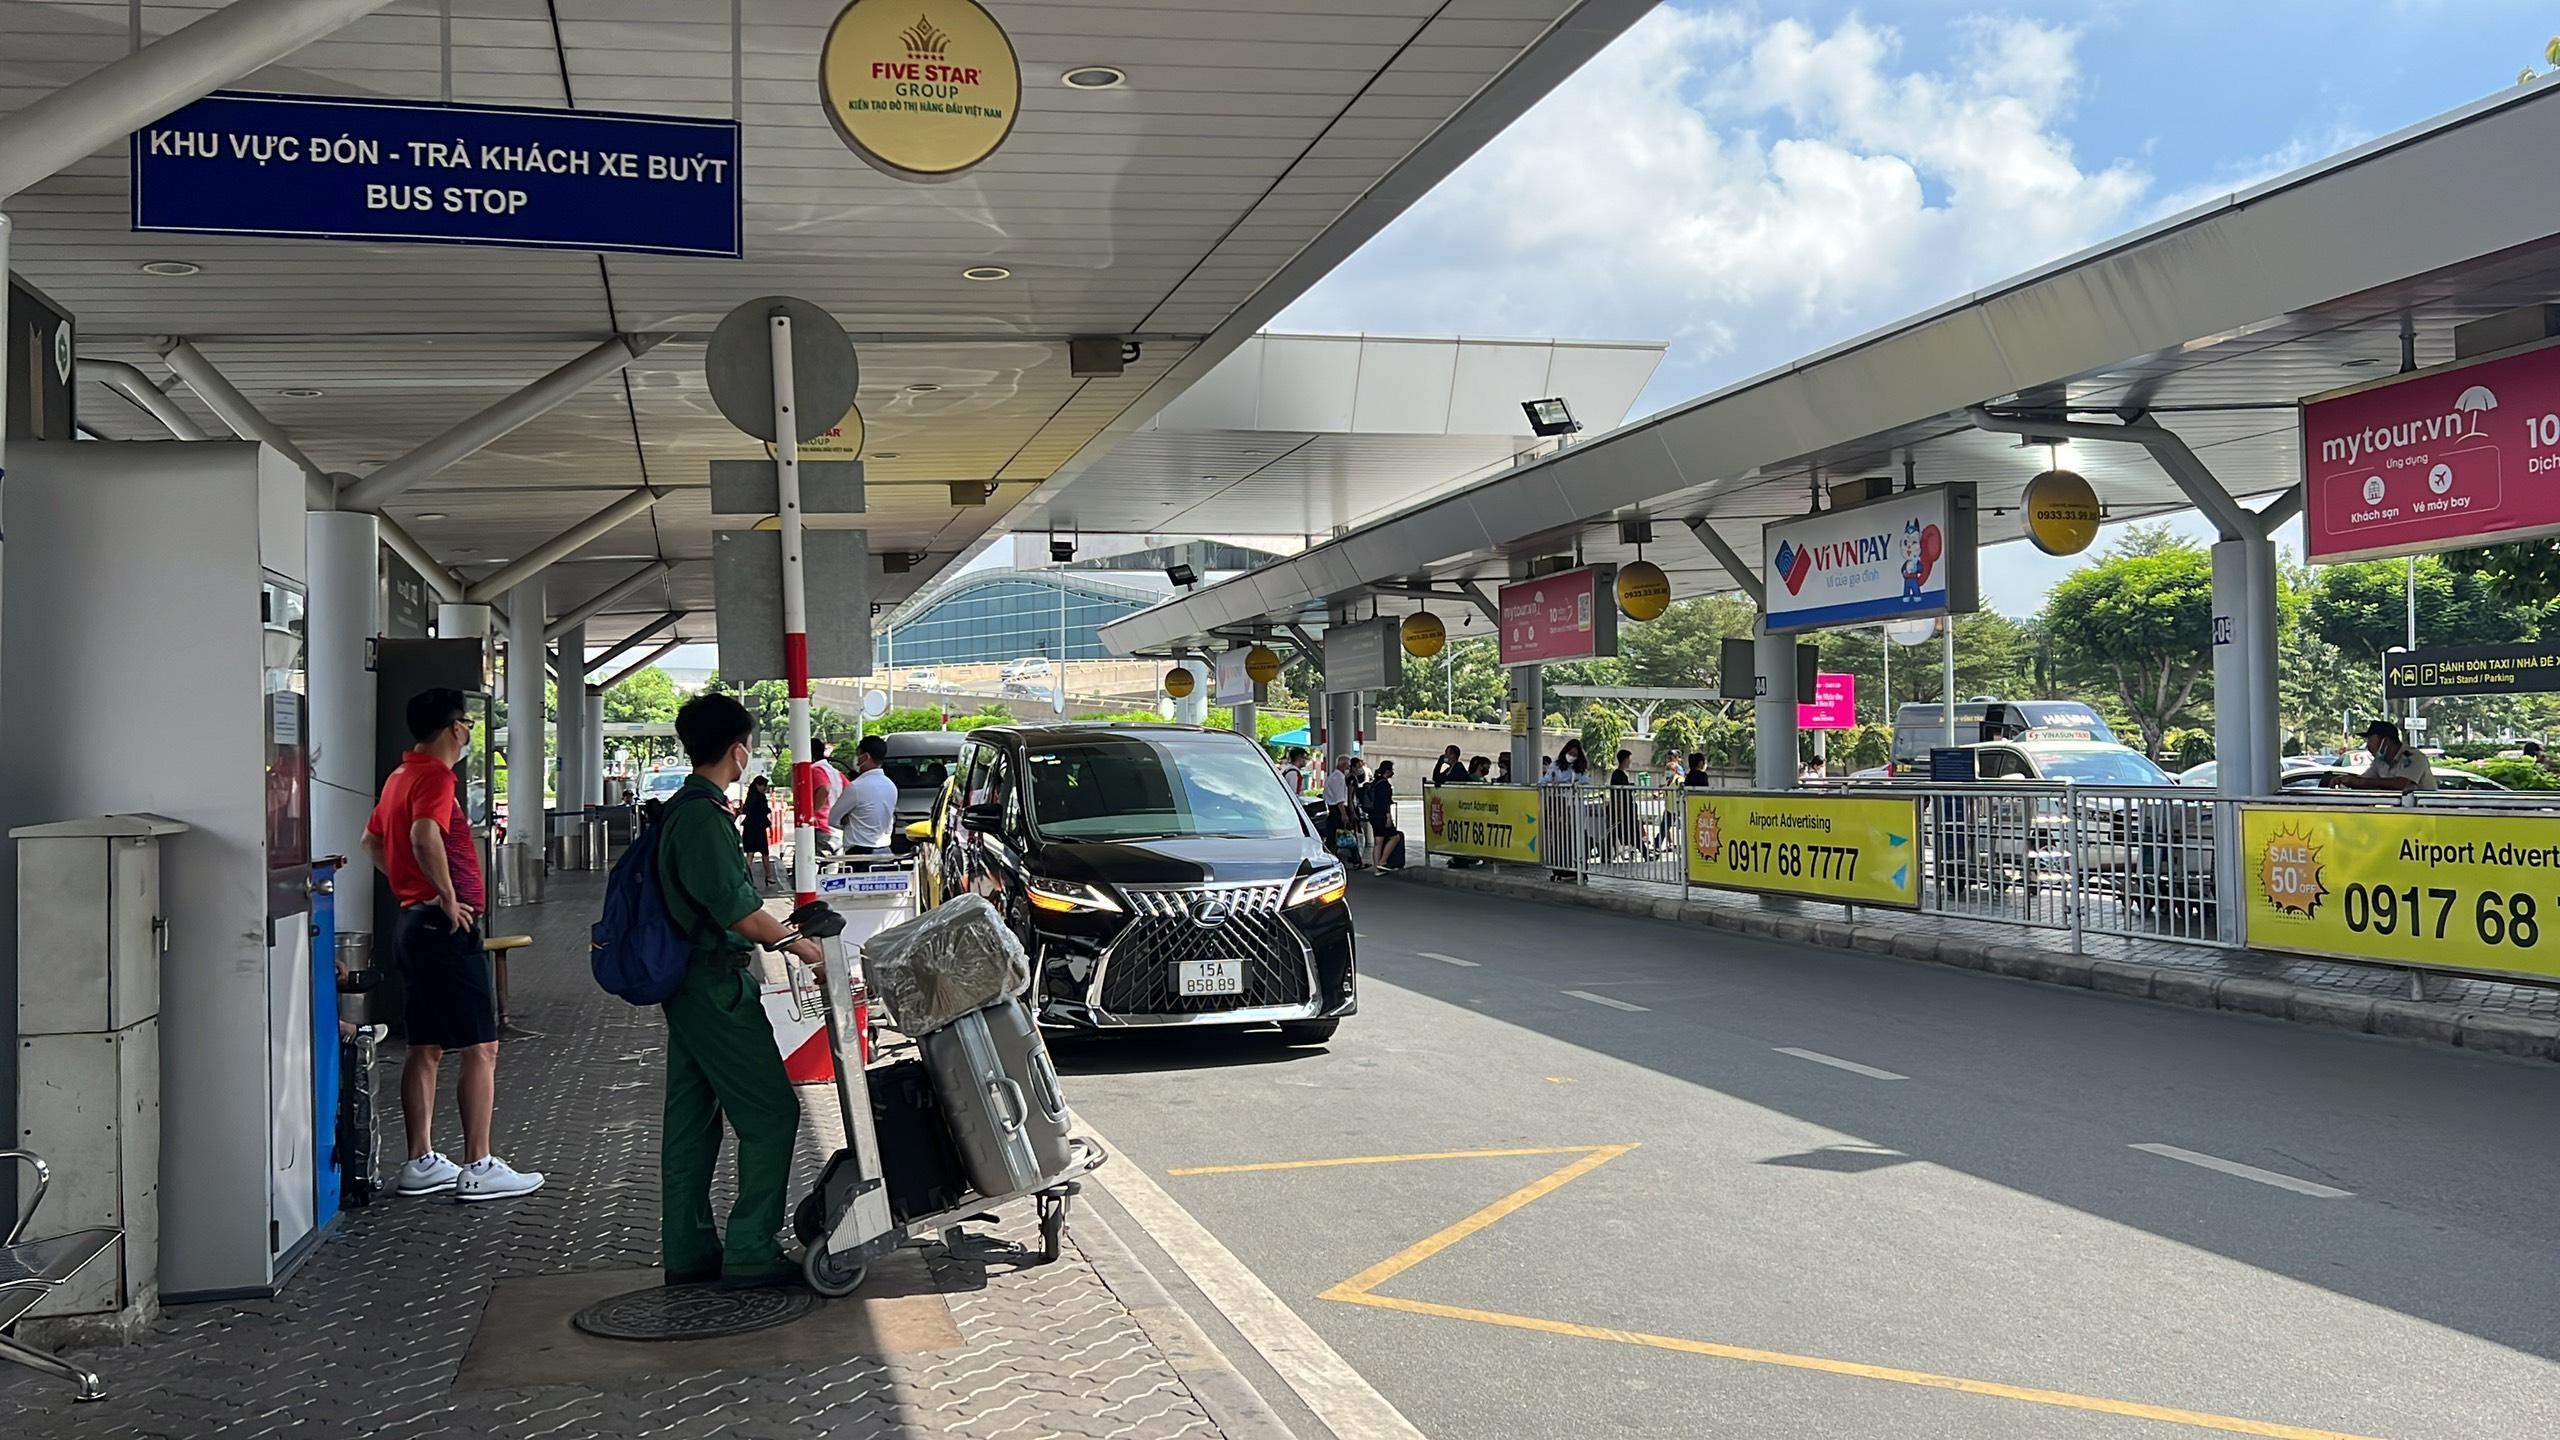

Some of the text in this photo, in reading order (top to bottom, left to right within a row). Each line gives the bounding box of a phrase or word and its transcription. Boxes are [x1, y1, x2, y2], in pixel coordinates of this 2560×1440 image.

[872, 63, 979, 85] FIVE STAR
[895, 83, 959, 99] GROUP
[920, 100, 943, 113] HÀNG
[964, 105, 982, 118] VIỆT
[984, 108, 1002, 119] NAM
[150, 130, 219, 158] KHU
[228, 133, 300, 166] VỰC
[308, 133, 379, 164] ĐÓN
[408, 138, 472, 169] TRẢ
[481, 142, 590, 175] KHÁCH
[599, 151, 639, 178] XE
[648, 153, 727, 183] BUÝT
[366, 184, 528, 215] BUS STOP
[2322, 412, 2462, 466] mytour.vn
[2405, 454, 2429, 467] dụng
[2427, 499, 2449, 511] máy
[2450, 496, 2471, 508] bay
[2351, 507, 2399, 523] Khách sạn
[1813, 533, 1892, 571] Ví VNPAY
[2489, 659, 2510, 670] TAXI
[2439, 675, 2455, 685] Taxi
[2457, 673, 2478, 684] Stand
[2484, 672, 2515, 684] Parking
[1749, 811, 1831, 833] Airport Advertising
[1447, 819, 1512, 848] 0917 68 7777
[1728, 839, 1859, 881] 0917 68 7777
[2271, 846, 2307, 864] SALE
[2399, 838, 2474, 868] Airport
[2299, 883, 2317, 893] OFF
[2344, 882, 2457, 939] 0917
[2475, 890, 2539, 949] 68
[1200, 963, 1224, 977] 15A
[1187, 978, 1235, 992] 858.89
